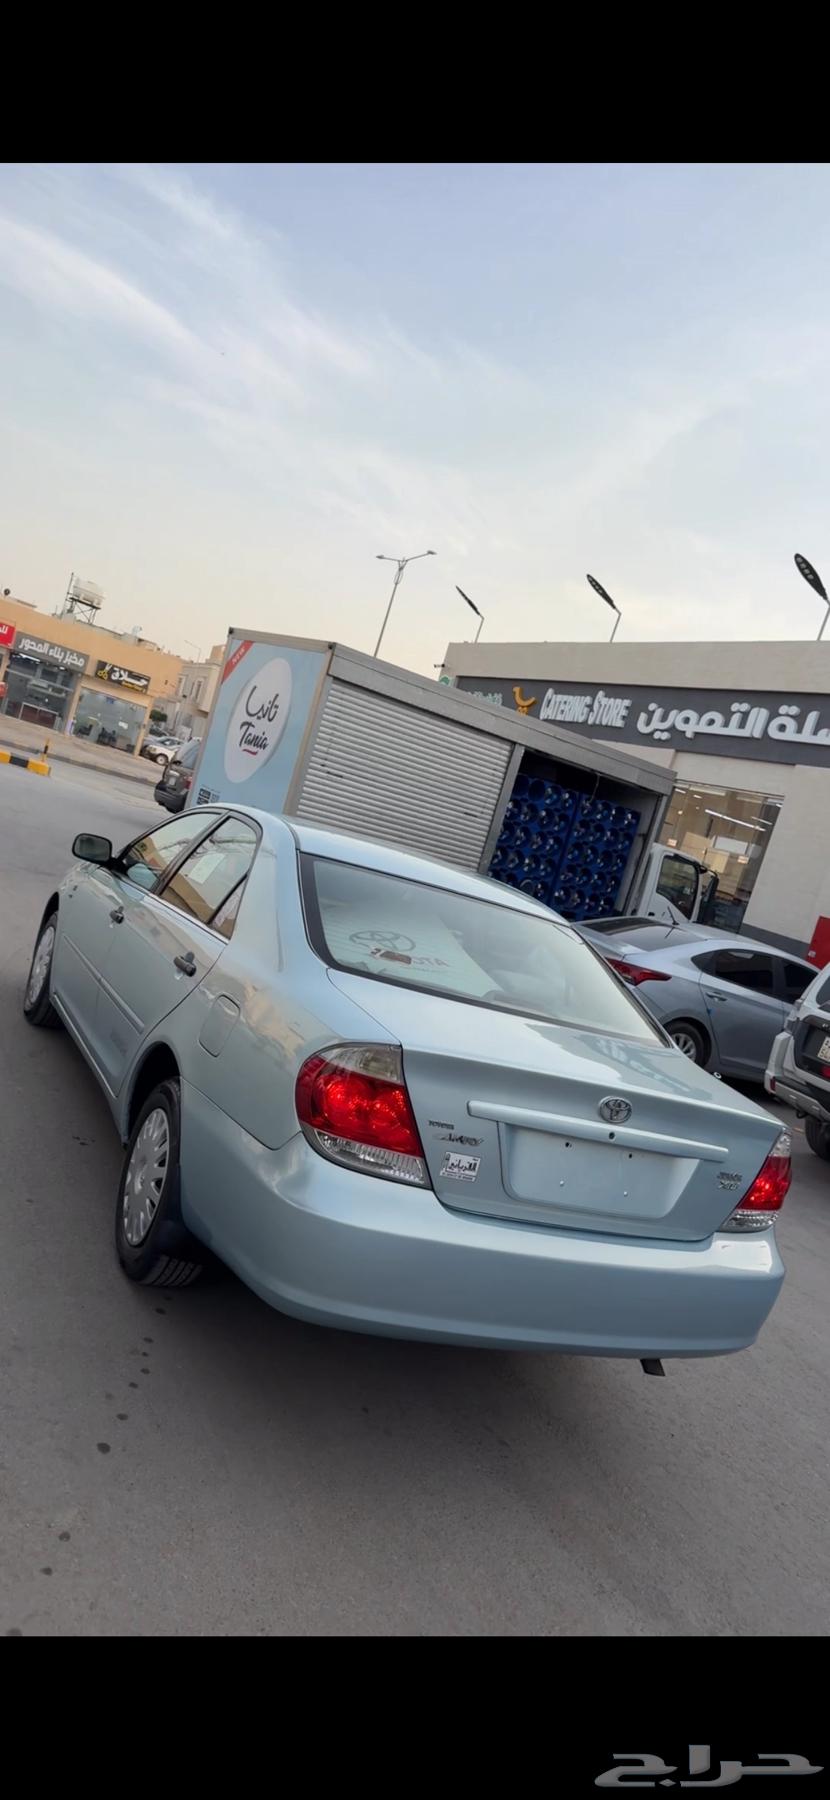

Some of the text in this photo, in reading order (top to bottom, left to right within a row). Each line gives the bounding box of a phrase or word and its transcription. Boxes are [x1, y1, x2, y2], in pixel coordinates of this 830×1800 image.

[19, 638, 50, 655] المحور
[63, 650, 85, 667] مخبز
[111, 667, 148, 686] حلاق
[245, 685, 279, 722] تانيا
[636, 702, 770, 741] التموين
[239, 721, 269, 750] Tania
